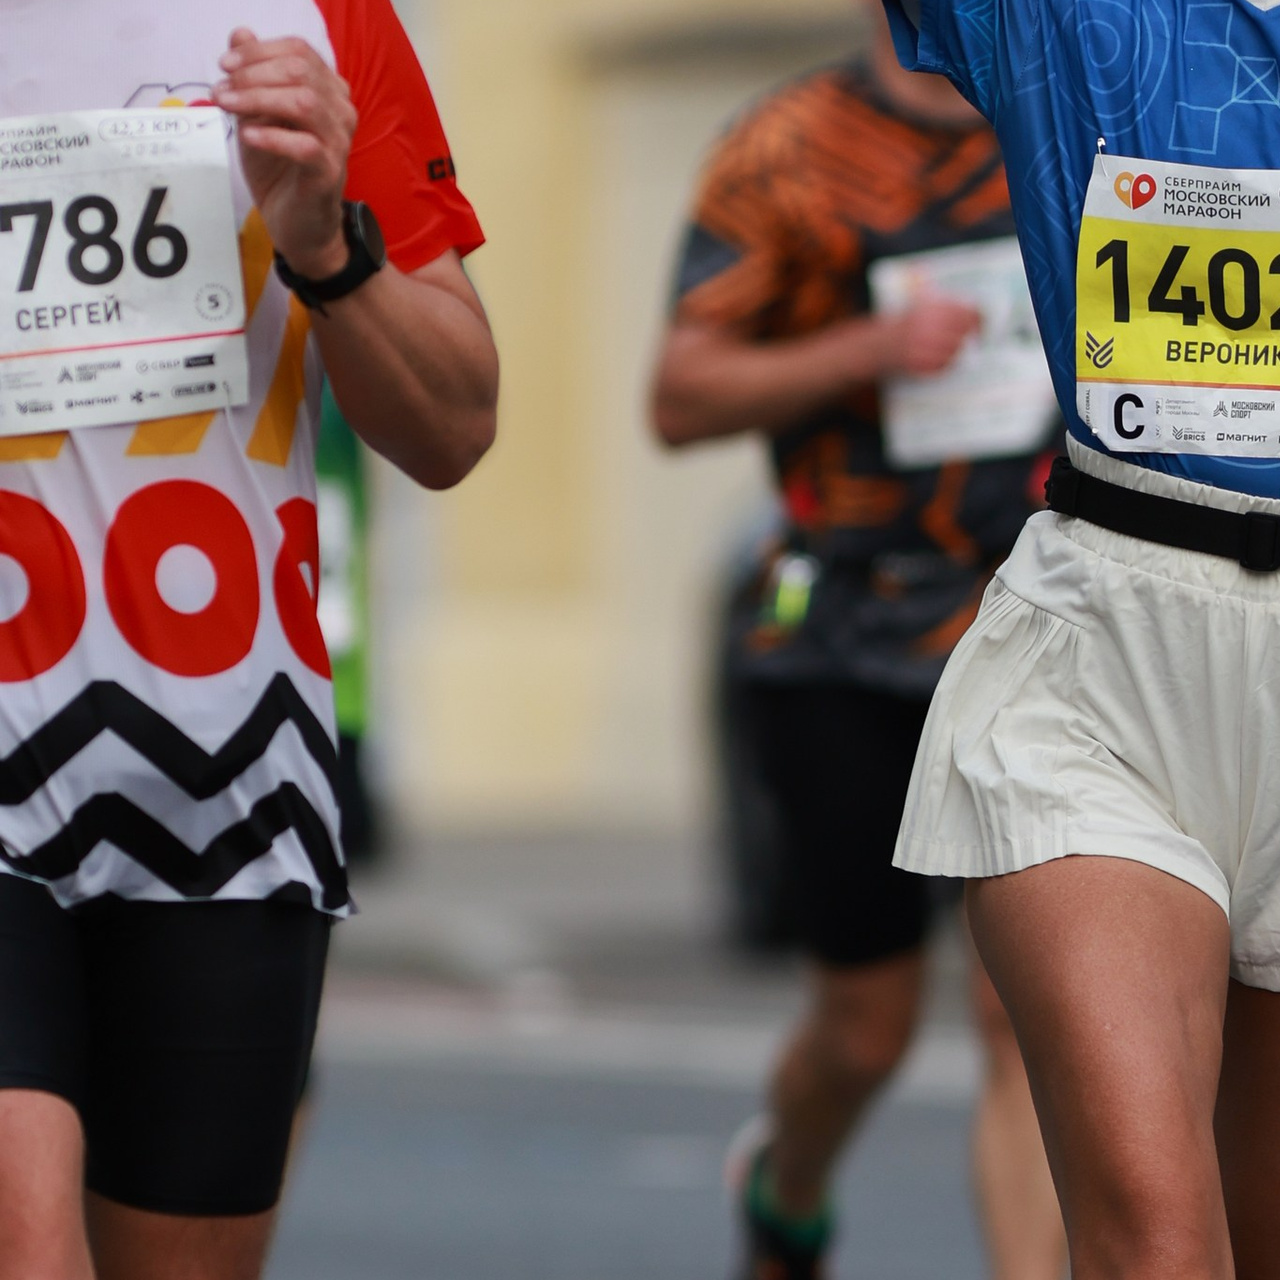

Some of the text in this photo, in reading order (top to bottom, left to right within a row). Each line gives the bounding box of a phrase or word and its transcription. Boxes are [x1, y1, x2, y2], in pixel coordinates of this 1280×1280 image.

[1164, 176, 1241, 192] СБЕРПРАЙМ
[1164, 188, 1271, 207] МОСКОВСКИЙ
[1163, 203, 1242, 220] МАРАФОН
[16, 295, 122, 332] СЕРГЕЙ
[1230, 408, 1252, 419] СПОРТ
[1231, 400, 1276, 411] МОСКОВСКИЙ
[1183, 433, 1206, 441] BRICS
